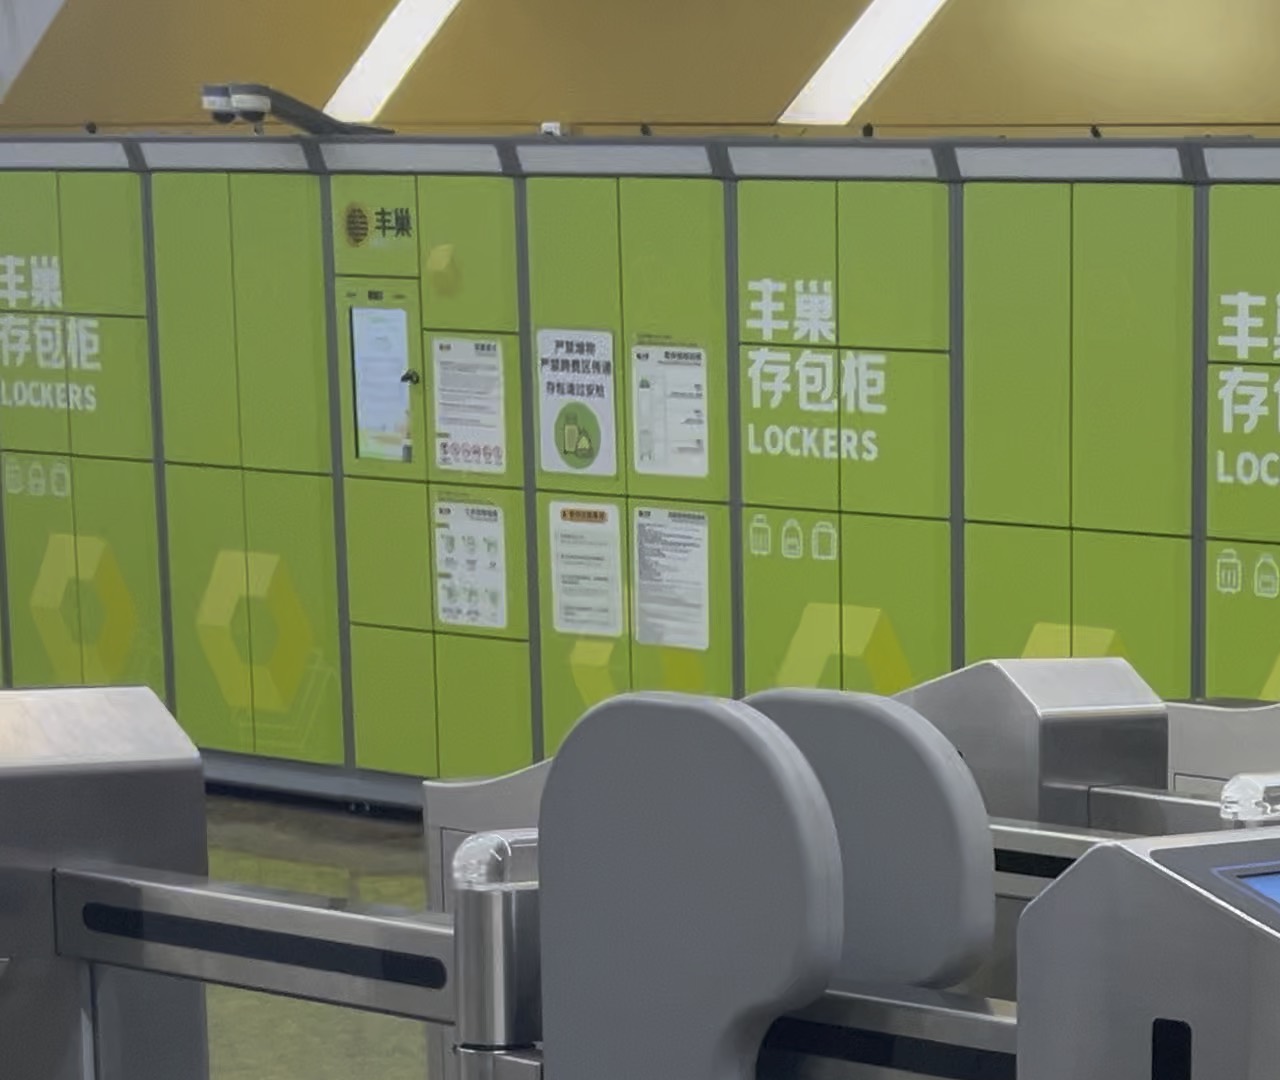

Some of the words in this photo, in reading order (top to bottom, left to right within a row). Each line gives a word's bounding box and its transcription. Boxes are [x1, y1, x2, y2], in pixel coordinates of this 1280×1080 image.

[374, 207, 412, 238] 丰巢
[0, 254, 63, 309] 丰巢
[746, 278, 836, 343] 丰巢
[0, 314, 102, 372] 存包柜
[0, 378, 97, 413] LOCKERS
[747, 347, 887, 414] 存包柜
[747, 423, 879, 462] LOCKERS
